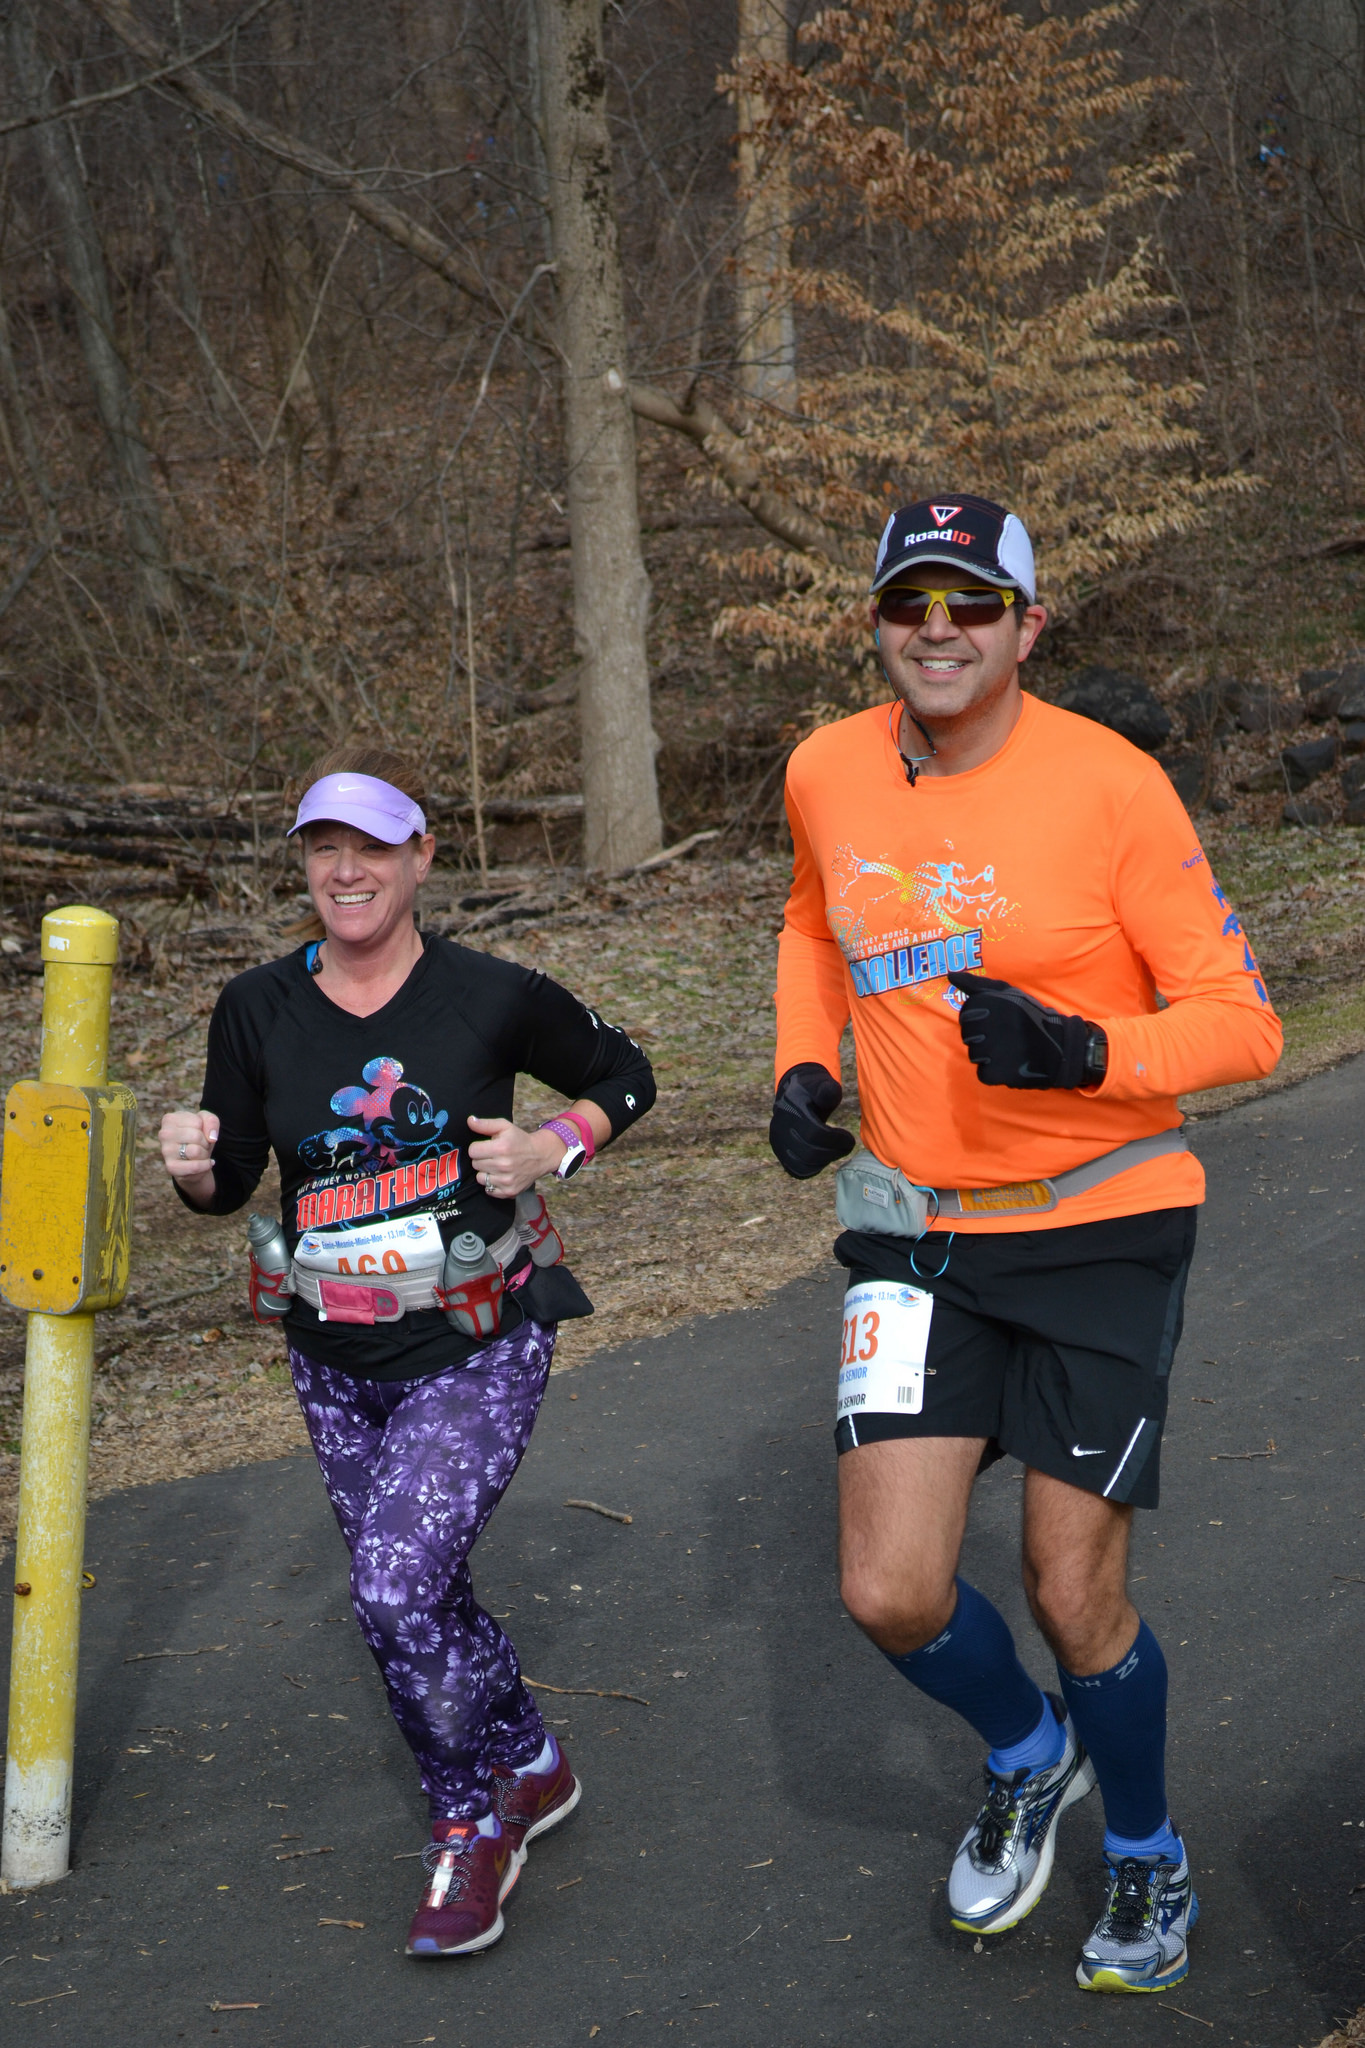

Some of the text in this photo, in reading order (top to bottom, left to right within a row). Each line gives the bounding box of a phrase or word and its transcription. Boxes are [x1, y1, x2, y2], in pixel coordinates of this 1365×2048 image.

[904, 529, 972, 547] RoadID
[867, 941, 890, 955] RACE
[892, 935, 910, 949] AND
[912, 933, 919, 944] A
[920, 927, 943, 941] HALF
[295, 1149, 459, 1232] MARATHON
[312, 1175, 340, 1190] DISNEY
[845, 1366, 868, 1383] SENIOR
[843, 1393, 866, 1409] SENIOR
